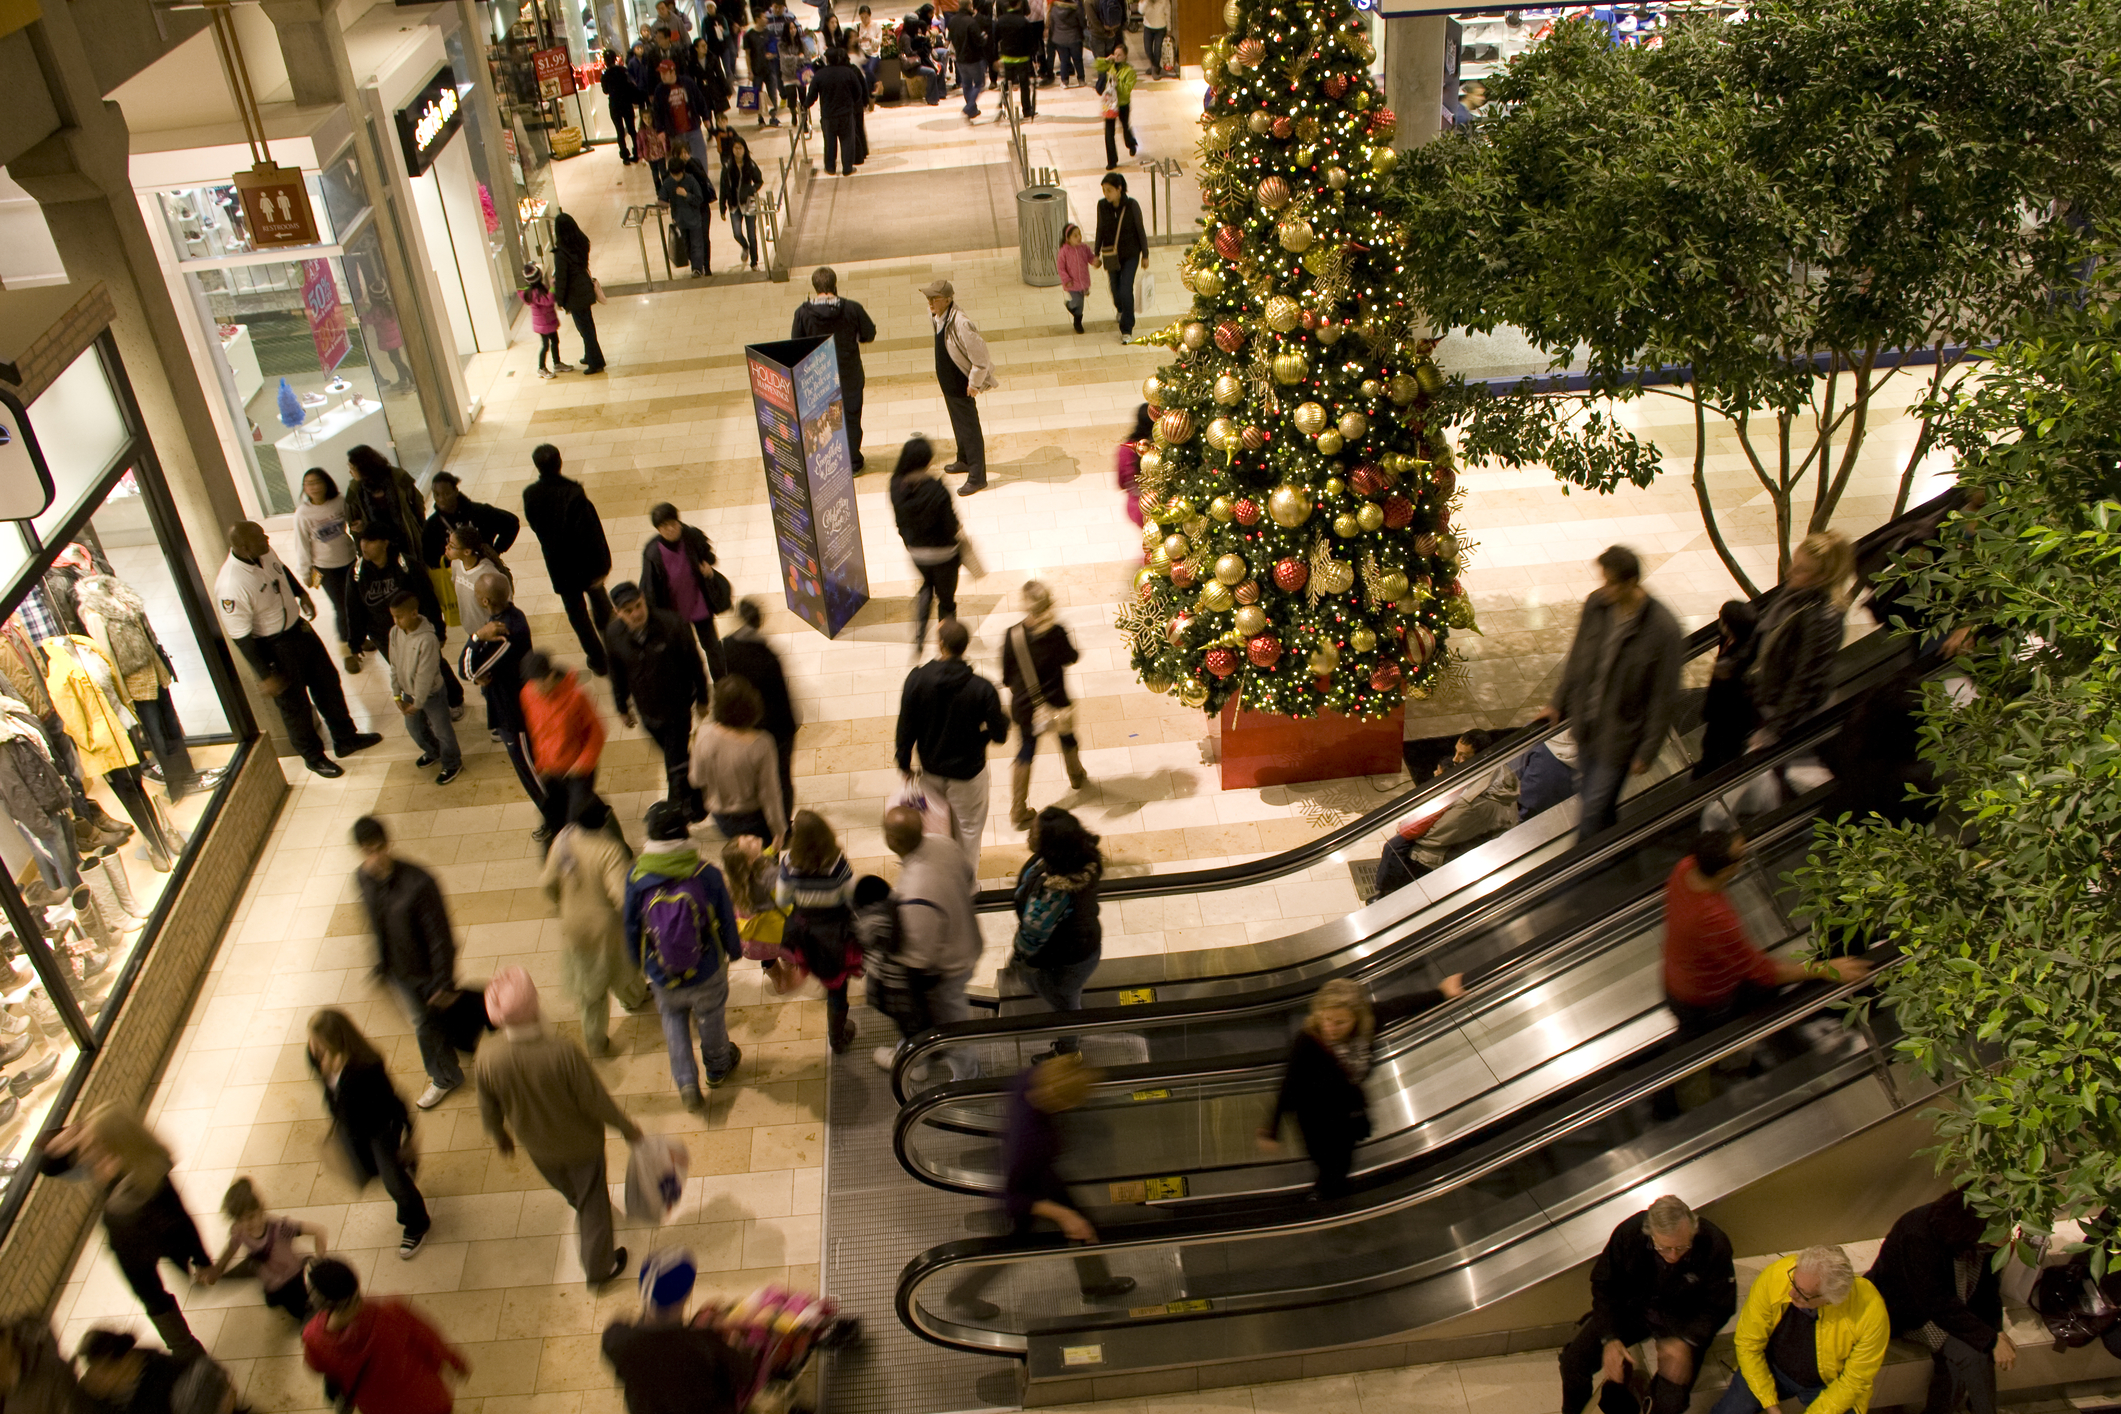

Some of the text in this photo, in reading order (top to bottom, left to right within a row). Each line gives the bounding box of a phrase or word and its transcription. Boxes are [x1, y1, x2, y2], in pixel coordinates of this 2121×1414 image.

[537, 53, 566, 71] $1.99
[262, 223, 300, 232] RESTROOMS
[750, 361, 791, 395] HOLIDAY
[757, 378, 790, 402] HAPPENINGS
[370, 577, 398, 595] NIKE
